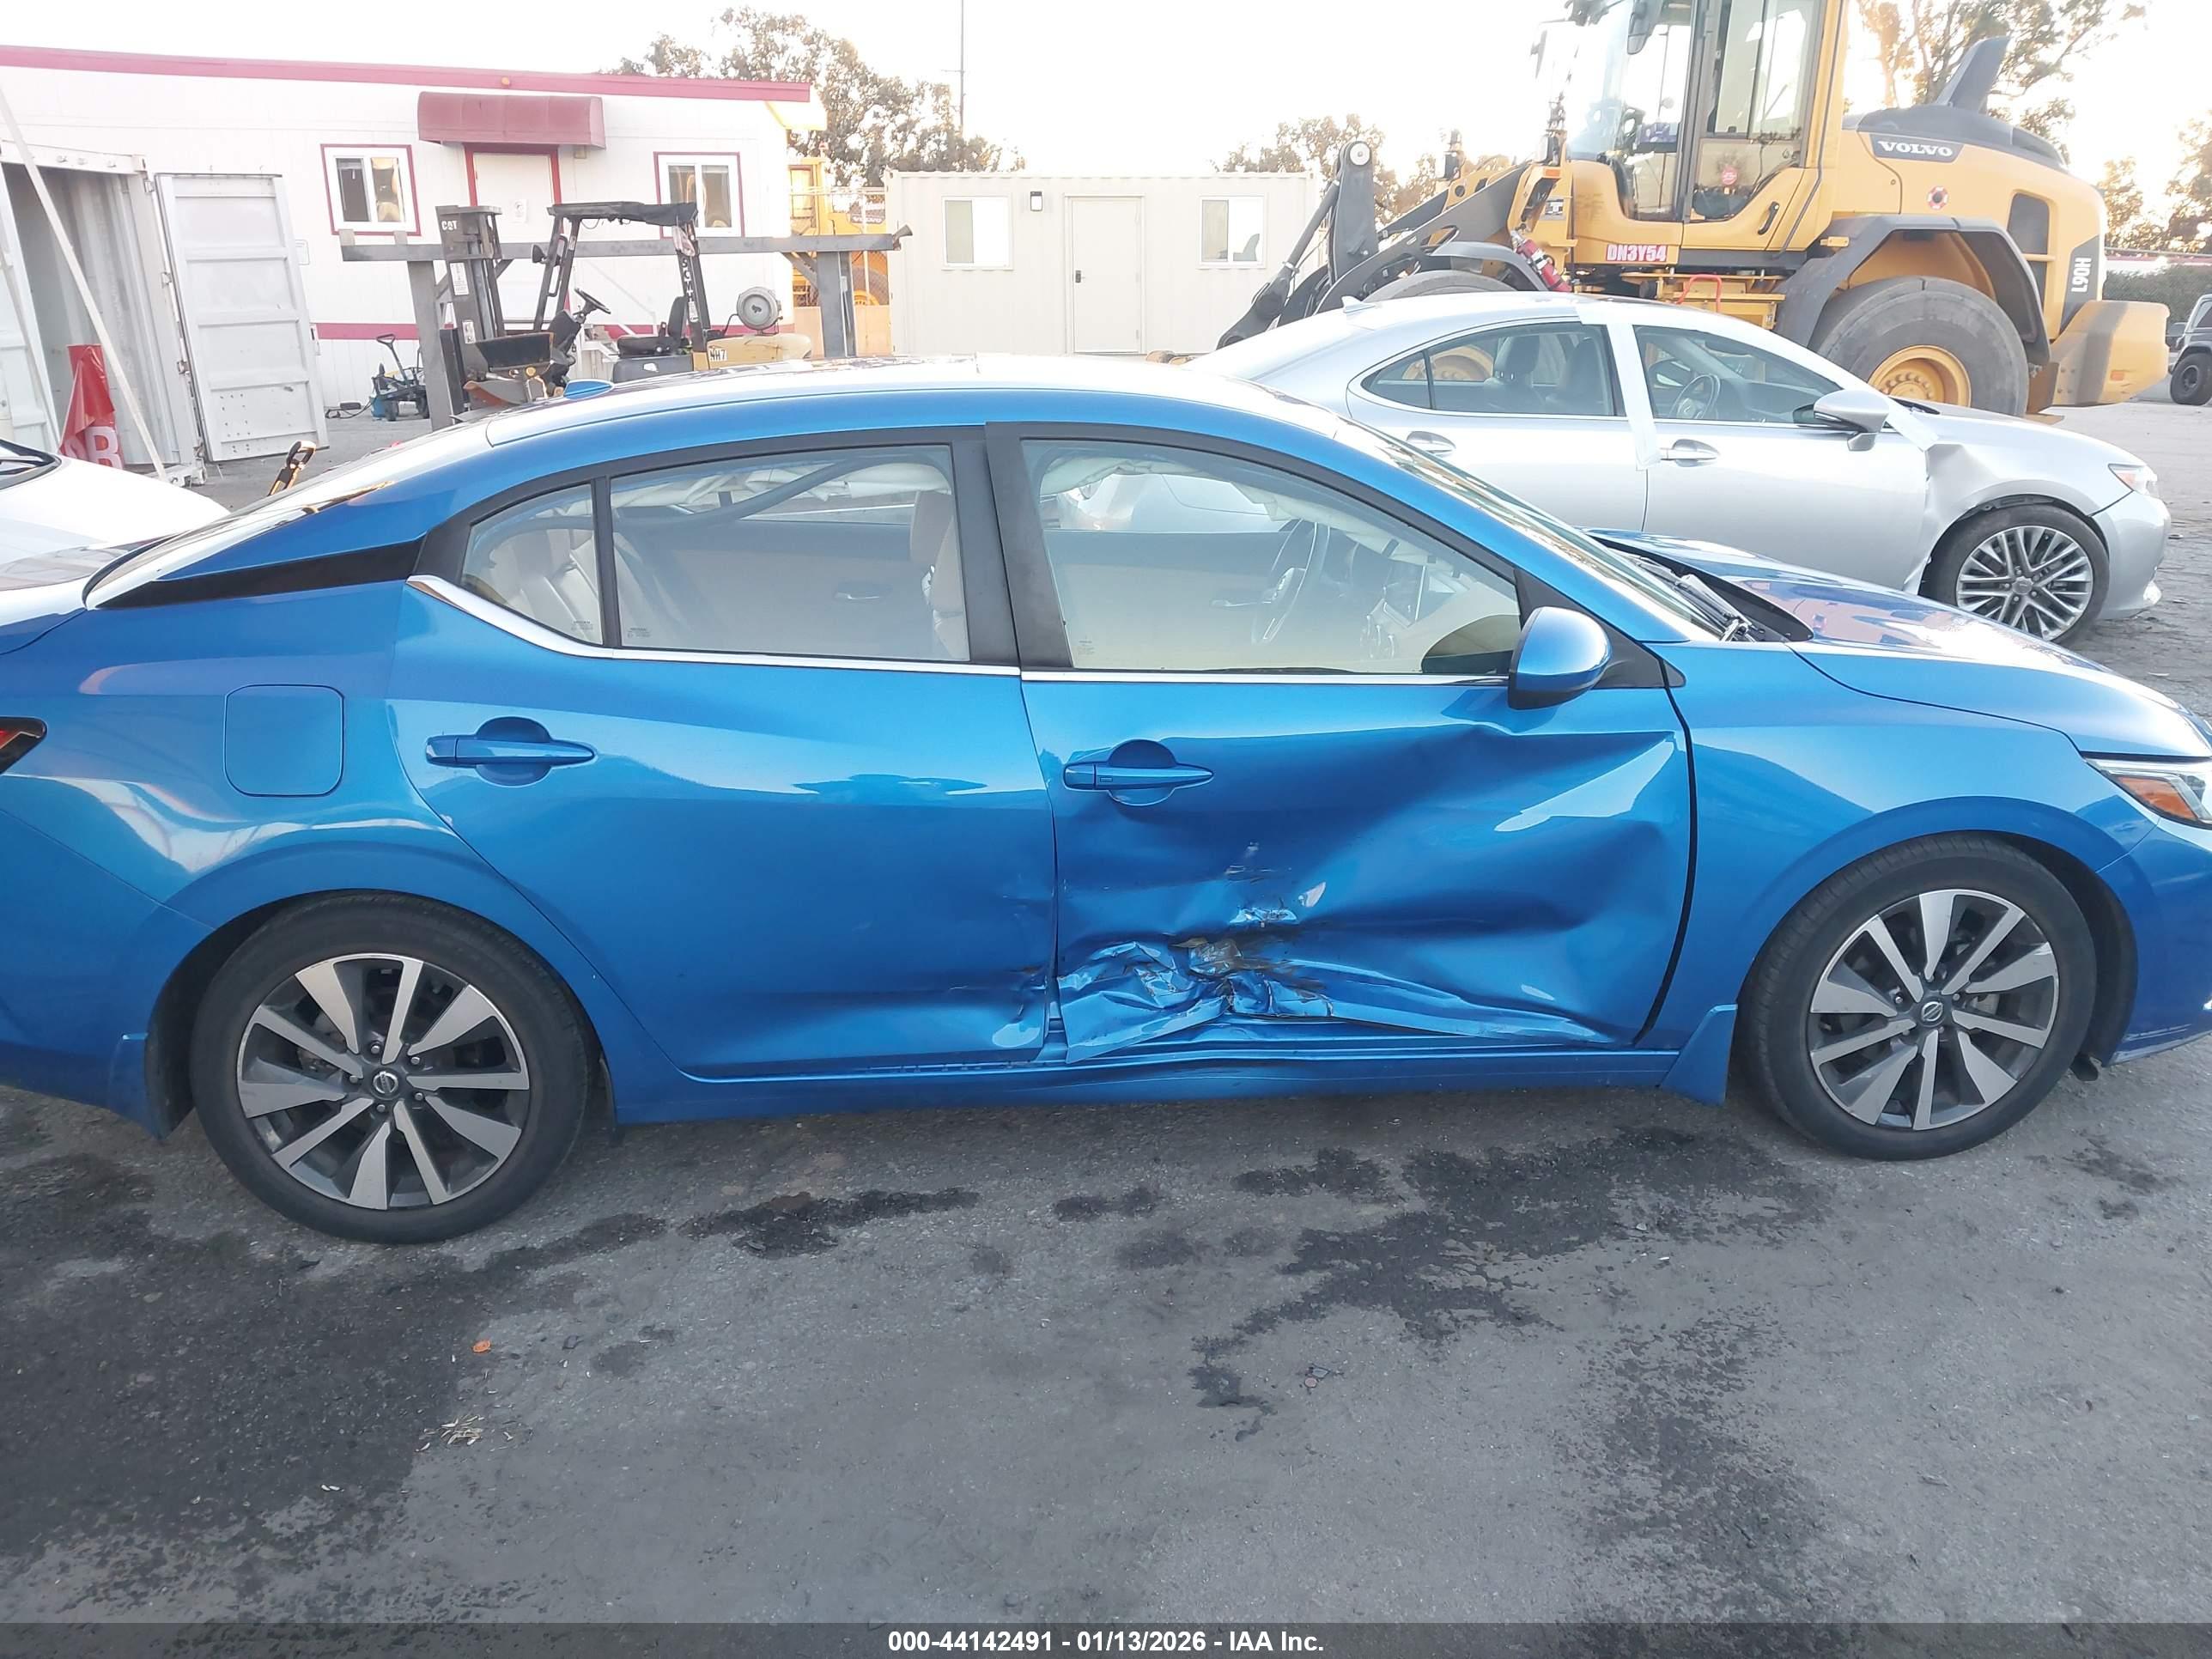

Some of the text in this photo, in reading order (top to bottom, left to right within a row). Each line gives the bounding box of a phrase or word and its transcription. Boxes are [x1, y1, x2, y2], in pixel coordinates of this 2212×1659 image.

[1877, 141, 1953, 156] VOLVO
[441, 220, 458, 231] CAT
[1607, 244, 1667, 262] DN3Y54
[2071, 258, 2092, 292] L90H
